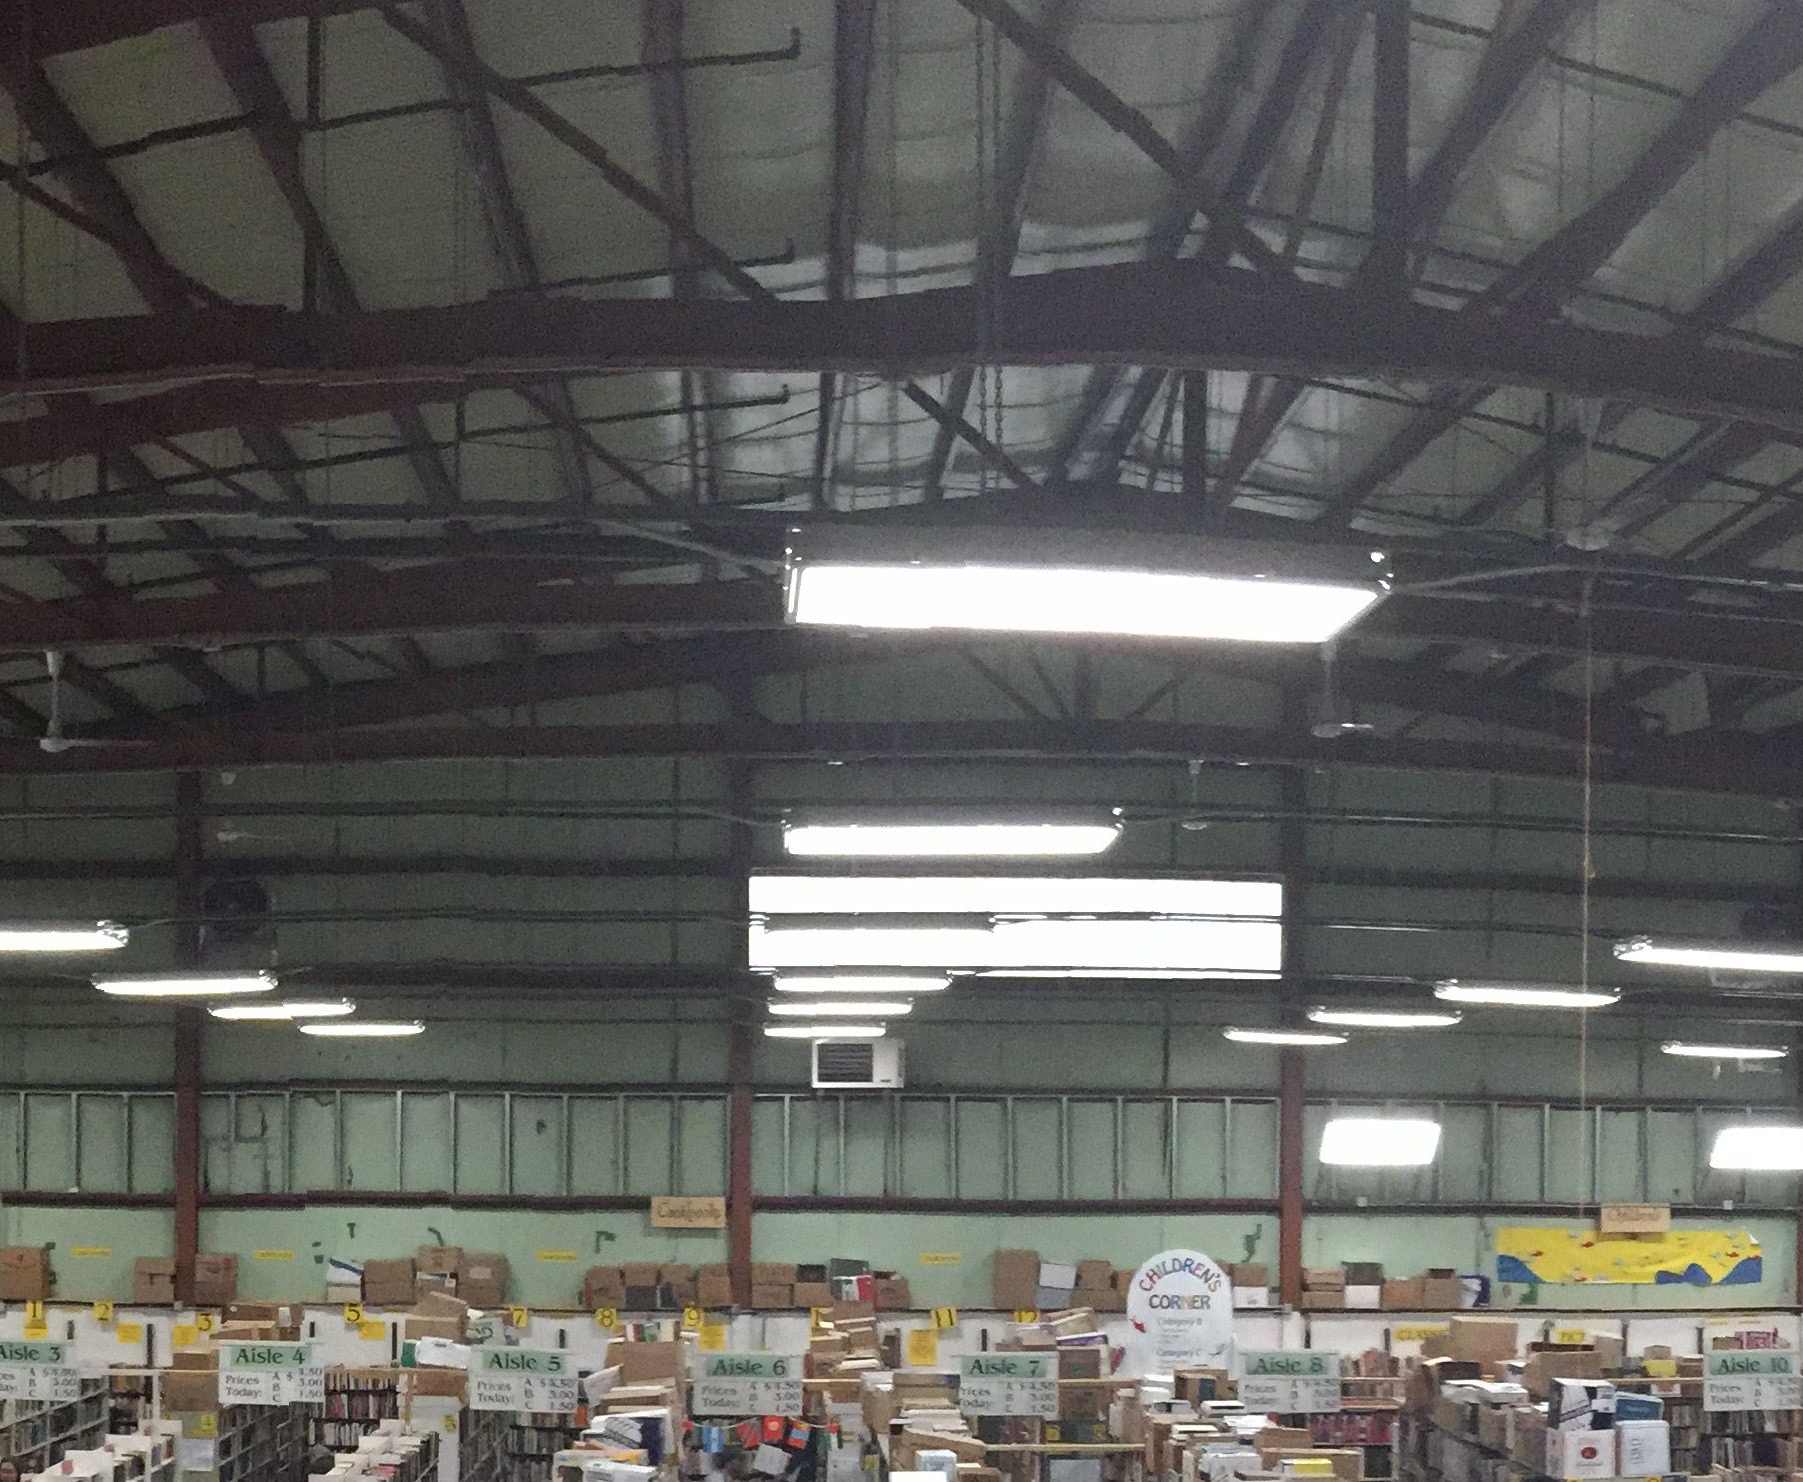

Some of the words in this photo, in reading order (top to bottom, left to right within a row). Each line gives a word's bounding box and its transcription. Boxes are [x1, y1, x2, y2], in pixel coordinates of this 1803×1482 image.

[1139, 1257, 1223, 1293] CHILDREN'S
[1148, 1294, 1211, 1310] CORNER
[98, 1305, 108, 1320] 2
[346, 1304, 361, 1322] 5
[513, 1309, 526, 1326] 7
[601, 1309, 613, 1328] 8
[687, 1308, 699, 1328] 9
[200, 1313, 211, 1329] 3
[49, 1345, 61, 1361] 3
[236, 1348, 284, 1364] Aisle
[287, 1348, 306, 1364] 4
[488, 1354, 538, 1371] Aisle
[546, 1354, 562, 1371] 5
[713, 1359, 764, 1376] Aisle
[772, 1359, 786, 1376] 6
[970, 1358, 1018, 1375] Aisle
[1029, 1360, 1041, 1377] 7
[1256, 1357, 1301, 1373] Aisle
[1311, 1357, 1324, 1373] 8
[1717, 1358, 1761, 1373] Aisle
[1770, 1357, 1790, 1373] 10
[226, 1375, 260, 1386] Prices
[477, 1380, 512, 1392] Prices
